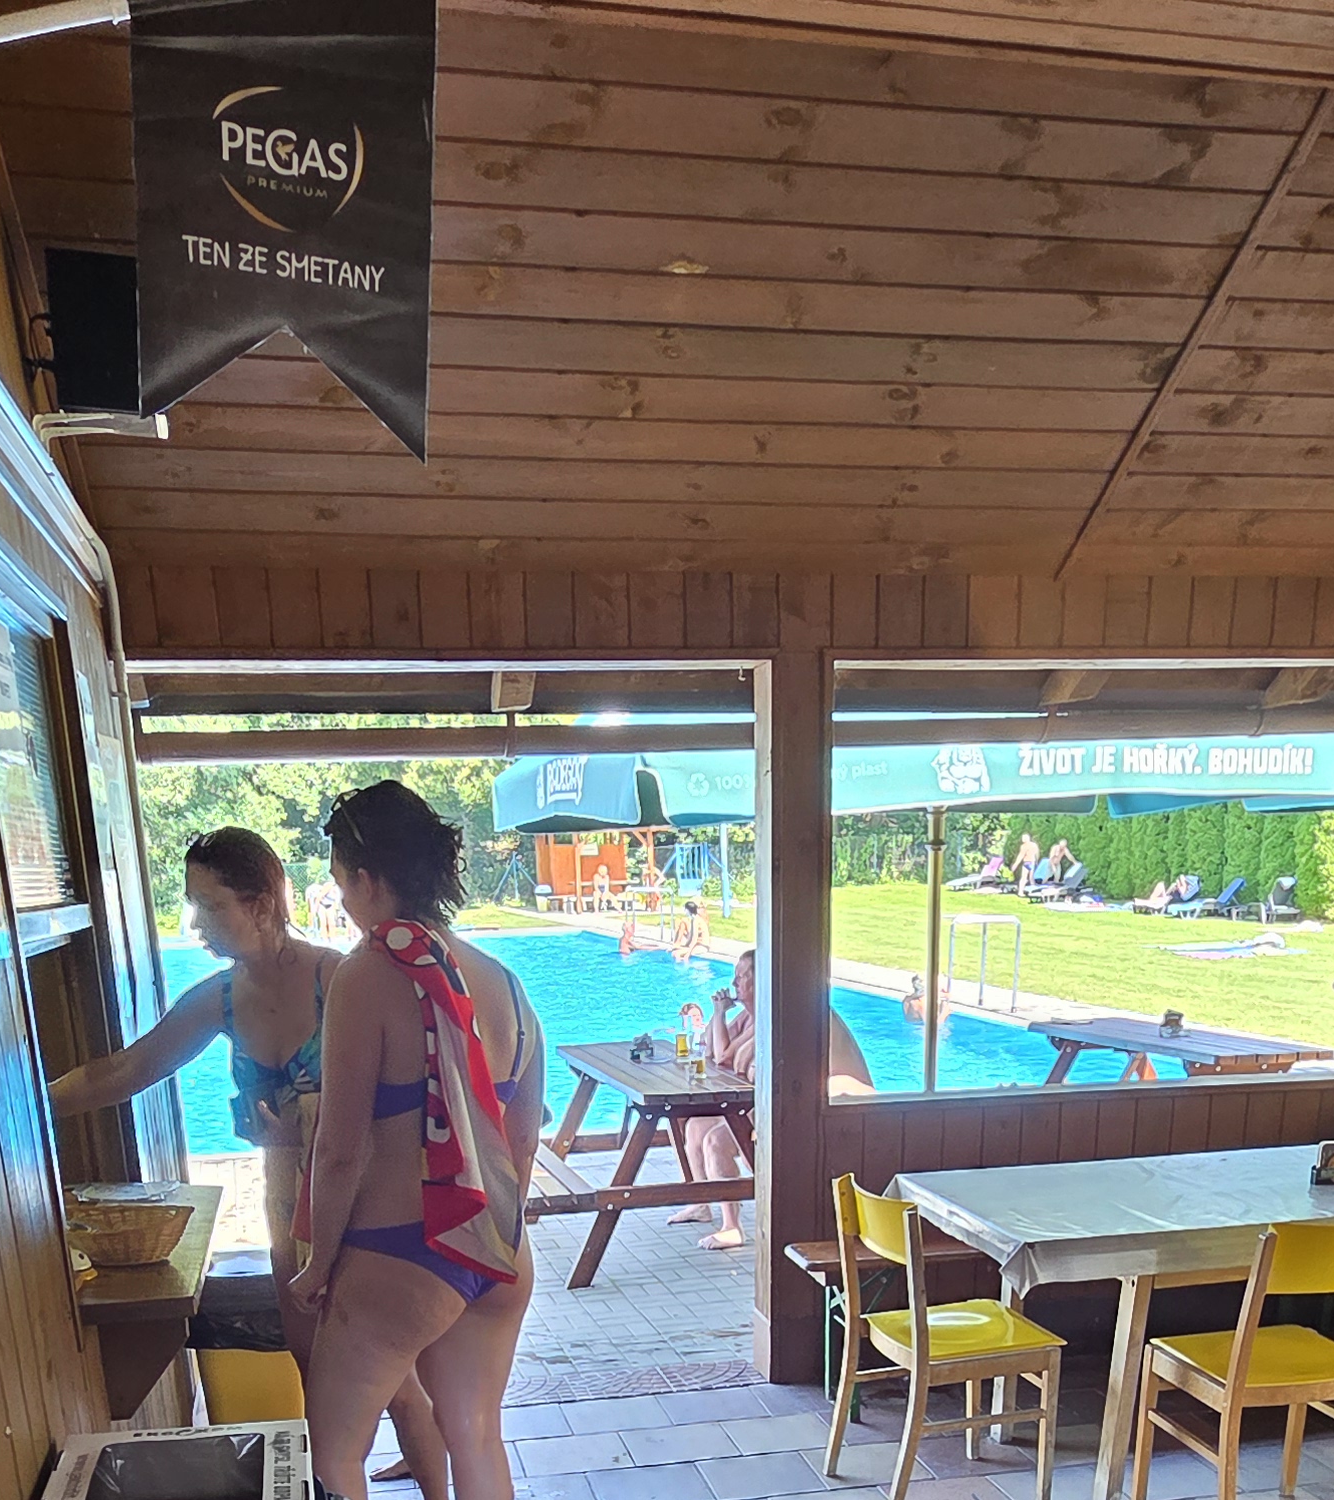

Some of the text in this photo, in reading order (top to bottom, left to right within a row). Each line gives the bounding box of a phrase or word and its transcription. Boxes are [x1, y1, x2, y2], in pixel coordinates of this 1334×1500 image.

[221, 120, 348, 181] PEGAS
[246, 175, 328, 199] PREMIUM
[182, 234, 230, 270] TEN
[276, 250, 385, 293] SMETANY
[1018, 742, 1314, 776] ŽIVOT JE HOŘKÝ. BOHUDÍK!
